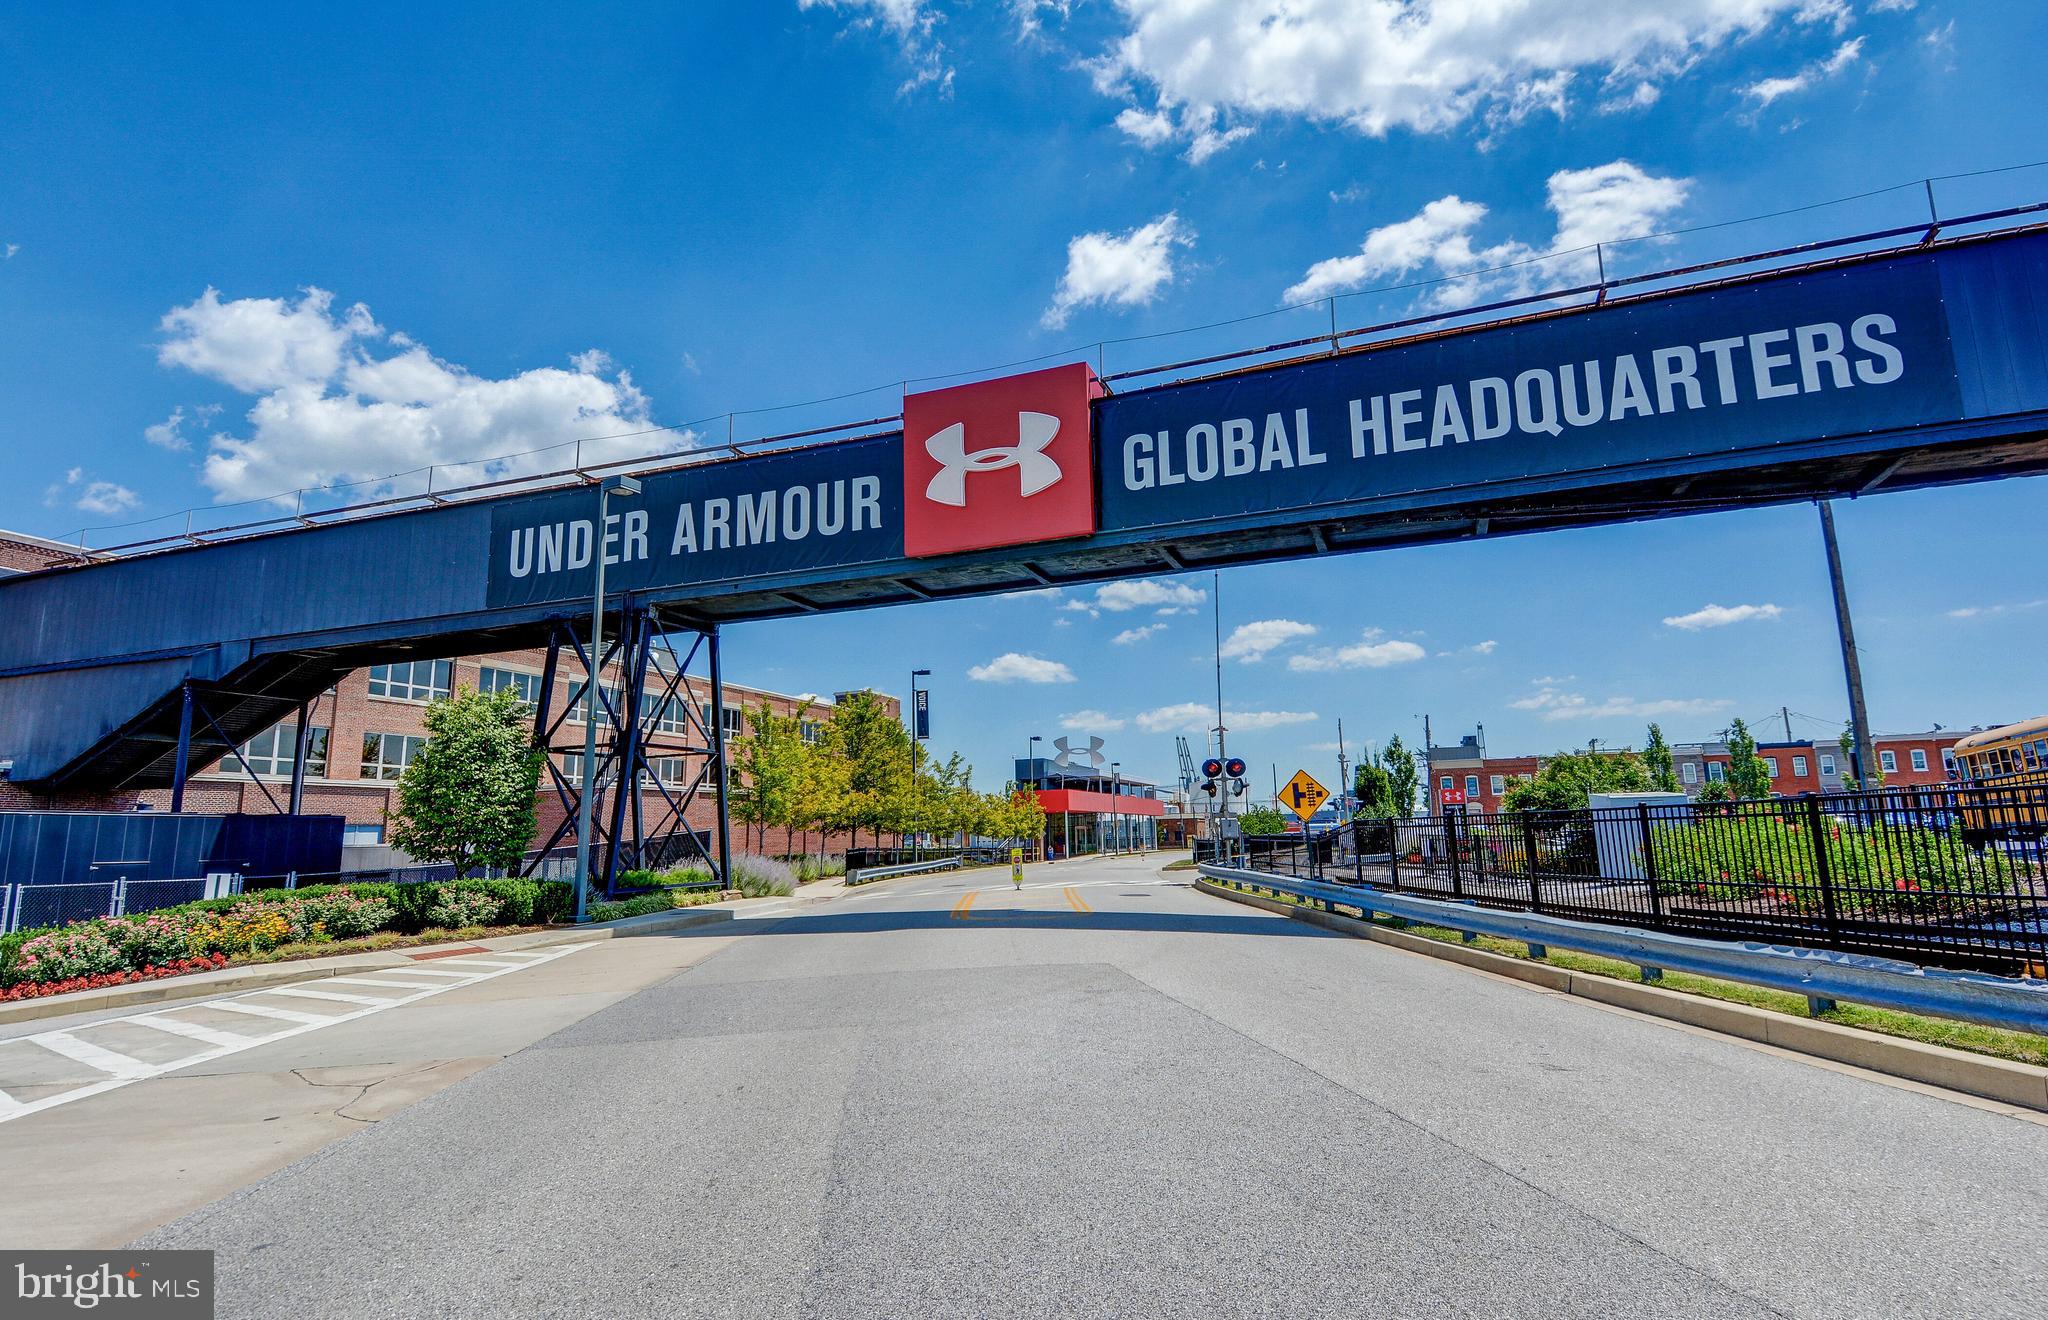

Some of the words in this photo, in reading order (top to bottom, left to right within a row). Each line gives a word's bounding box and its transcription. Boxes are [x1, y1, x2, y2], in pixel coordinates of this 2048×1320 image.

[1123, 407, 1327, 491] GLOBAL
[1349, 313, 1905, 459] HEADQUARTERS
[510, 509, 649, 578] UNDER
[671, 475, 883, 556] ARMOUR
